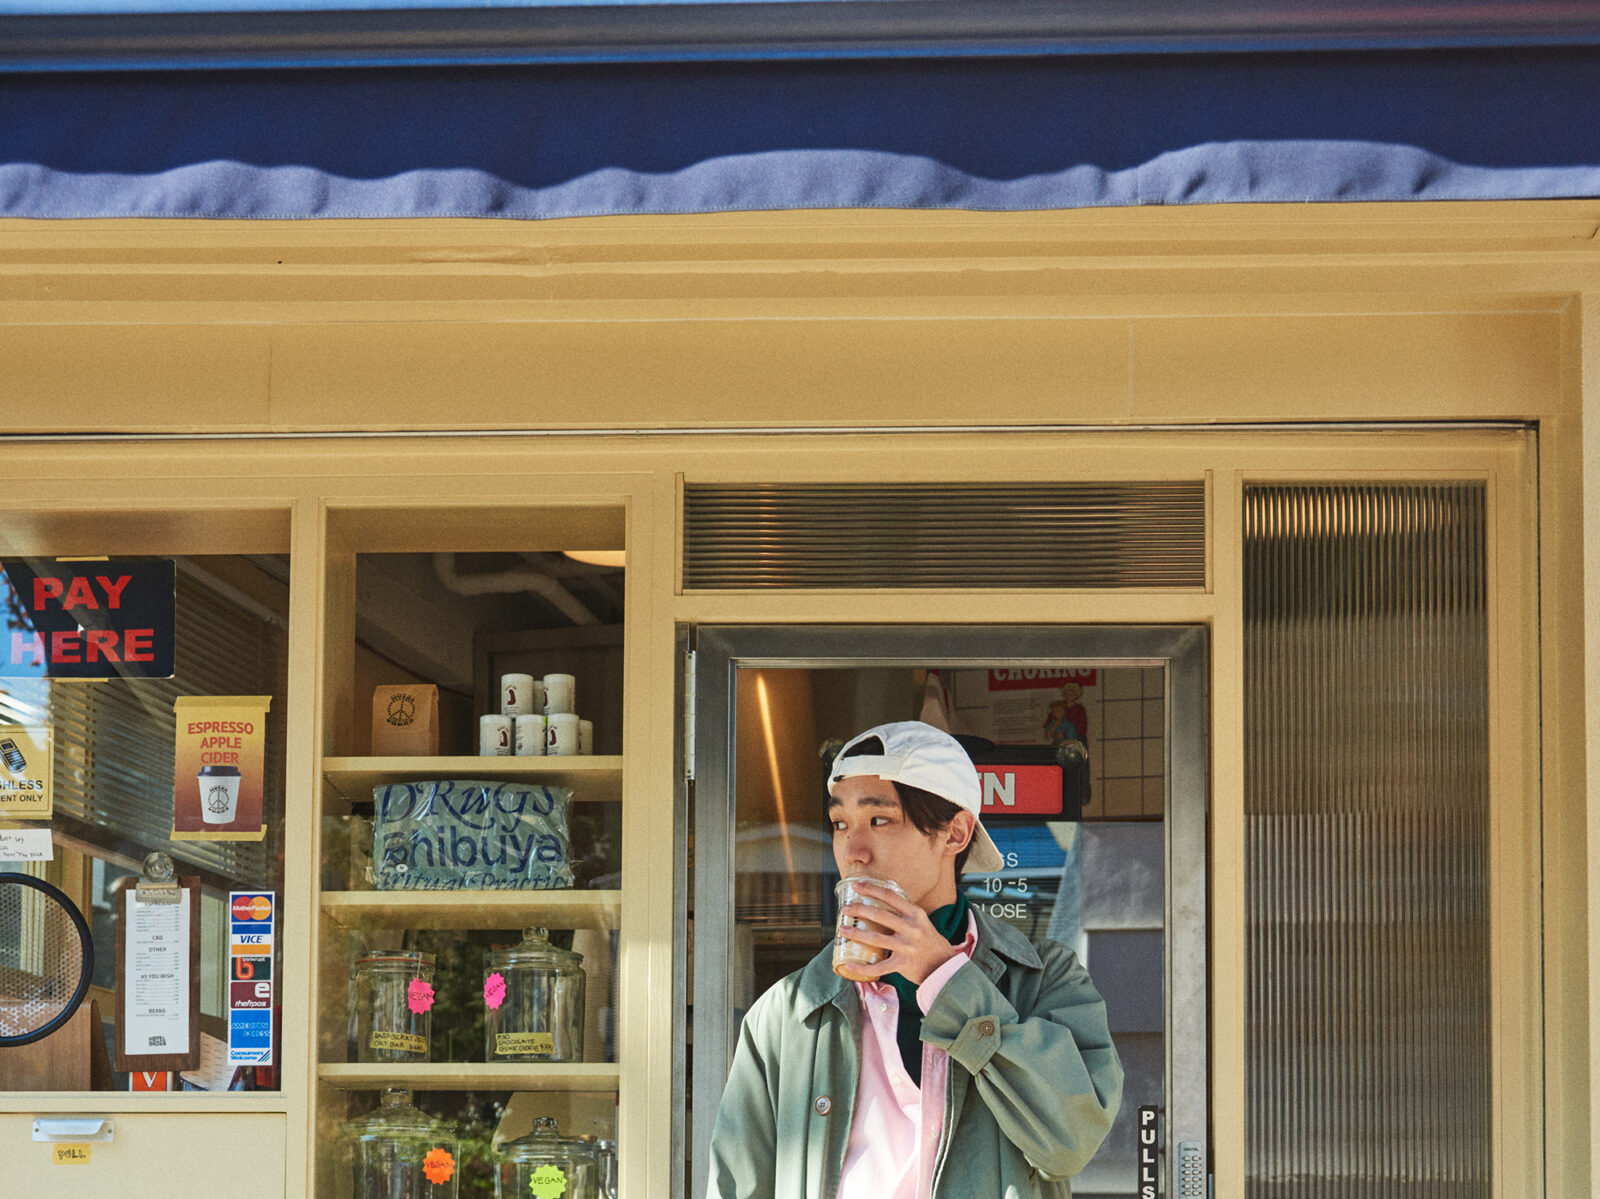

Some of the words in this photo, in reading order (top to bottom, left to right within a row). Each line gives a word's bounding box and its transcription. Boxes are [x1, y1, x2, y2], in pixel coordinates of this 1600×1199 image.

[33, 575, 133, 611] PAY
[10, 628, 155, 664] HERE
[187, 721, 254, 735] ESPRESSO
[200, 736, 242, 749] APPLE
[200, 751, 240, 764] CIDER
[0, 779, 43, 790] HLESS
[976, 772, 1016, 806] N
[19, 794, 43, 802] ONLY
[972, 903, 1027, 919] OSE
[240, 935, 264, 944] VICE
[57, 1149, 87, 1160] PULL
[425, 1161, 454, 1169] VEGAN
[532, 1176, 564, 1185] VEGAN
